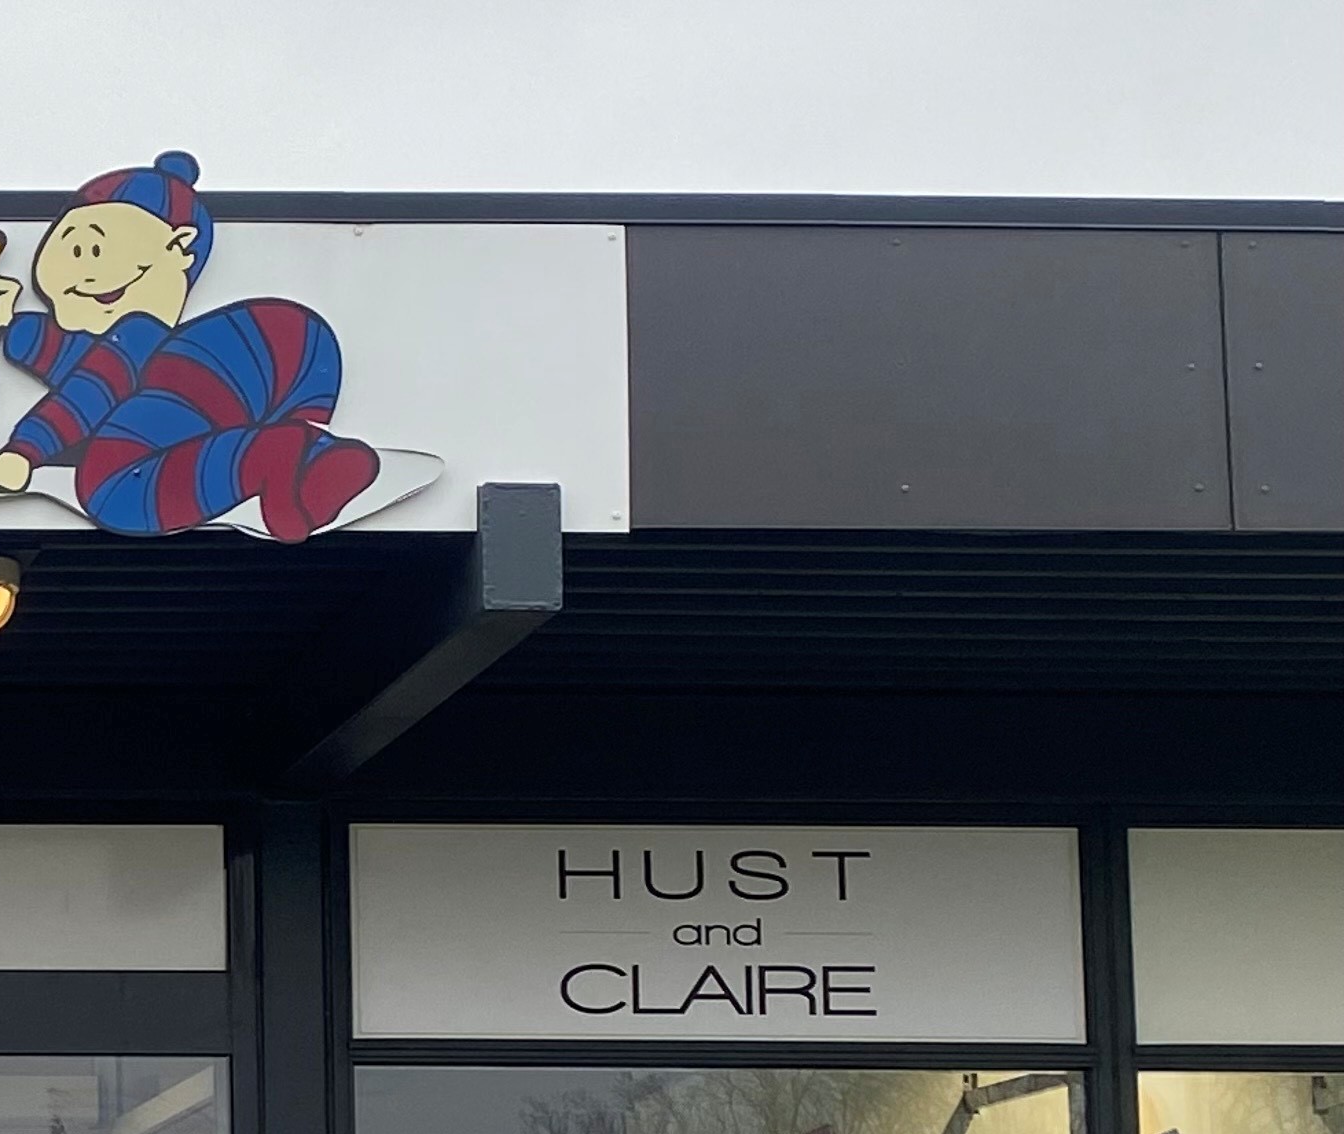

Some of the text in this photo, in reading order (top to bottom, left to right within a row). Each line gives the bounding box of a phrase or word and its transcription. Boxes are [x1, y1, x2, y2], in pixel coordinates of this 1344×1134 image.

[558, 849, 871, 901] HUST
[672, 917, 762, 946] and
[560, 963, 878, 1017] CLAIRE
